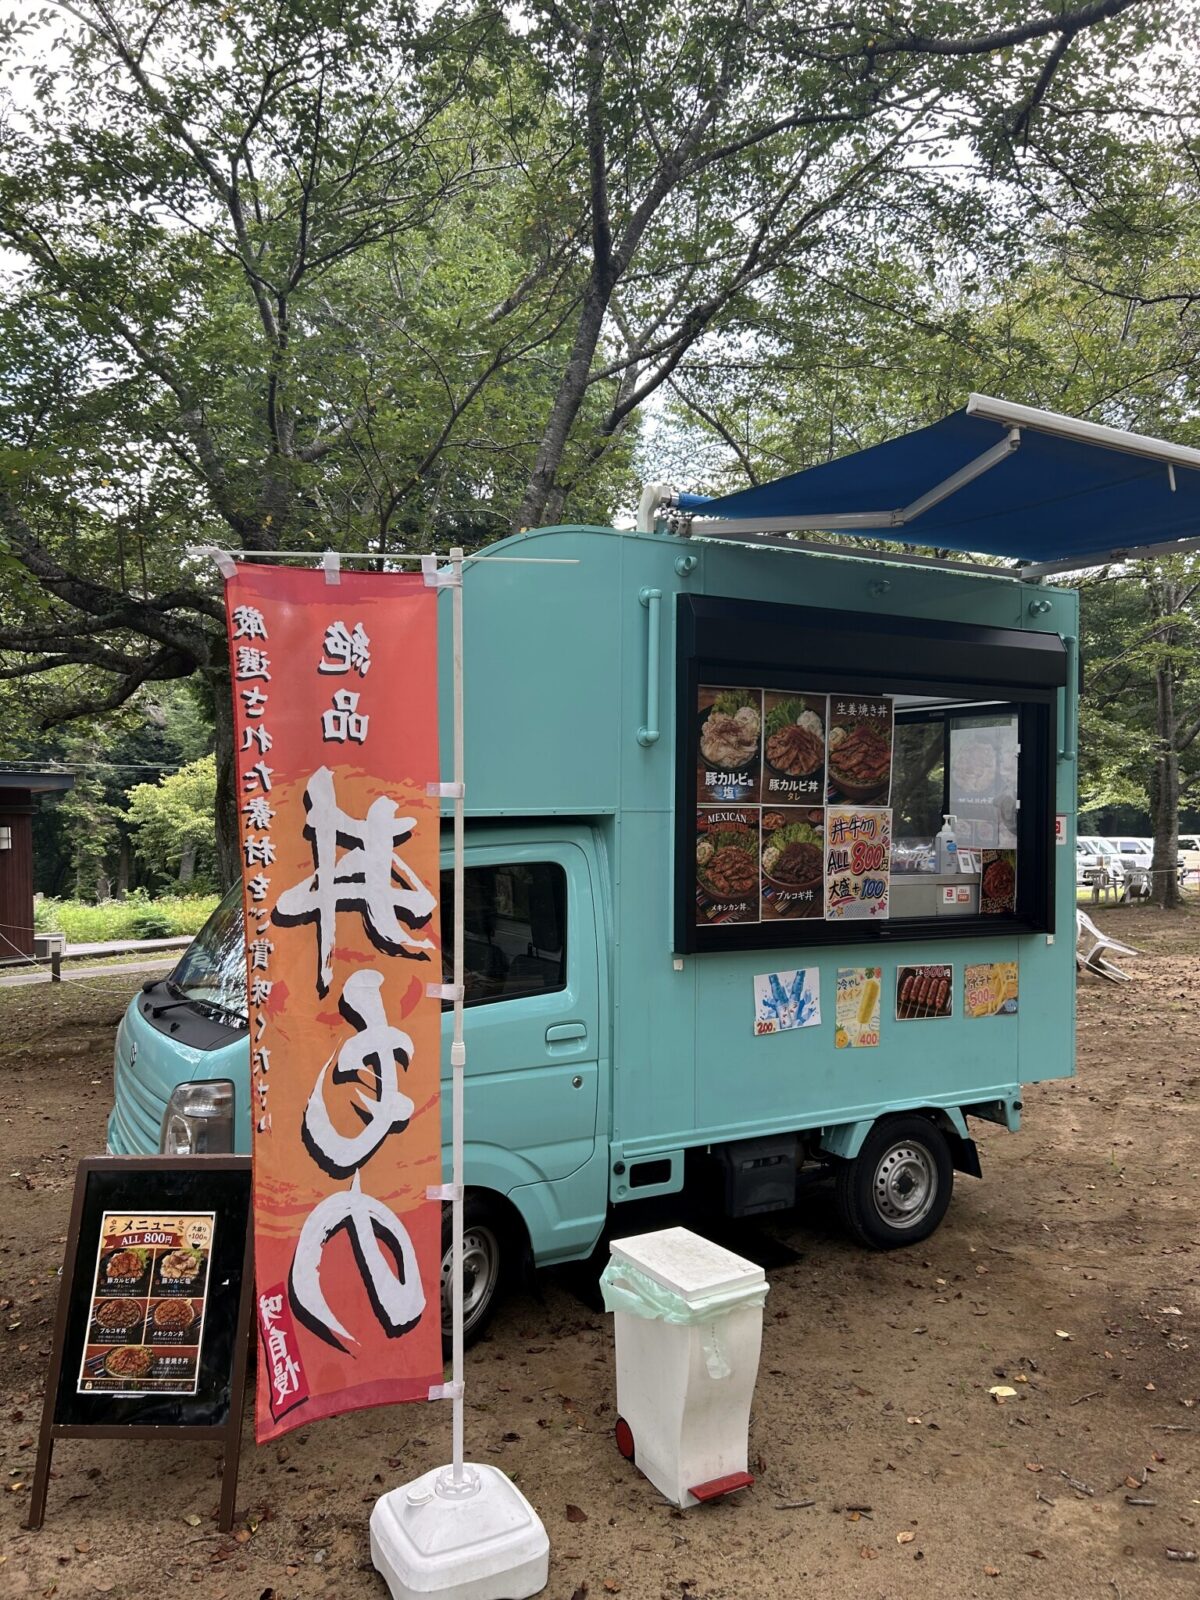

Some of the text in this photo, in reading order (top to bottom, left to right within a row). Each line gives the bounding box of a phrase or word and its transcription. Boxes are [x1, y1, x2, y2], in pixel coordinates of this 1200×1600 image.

[768, 778, 819, 792] 豚カルビ丼
[723, 786, 735, 799] 塩
[787, 792, 800, 801] タレ
[707, 812, 747, 824] MEXICAN
[827, 840, 889, 876] ALL 800円
[776, 889, 814, 901] ブルコギ丼
[711, 902, 747, 912] メキシカン丼
[836, 978, 860, 991] 冷やし
[120, 1219, 176, 1233] メニュー
[121, 1232, 173, 1246] ALL 800円
[100, 1327, 127, 1335] ブルコギ丼
